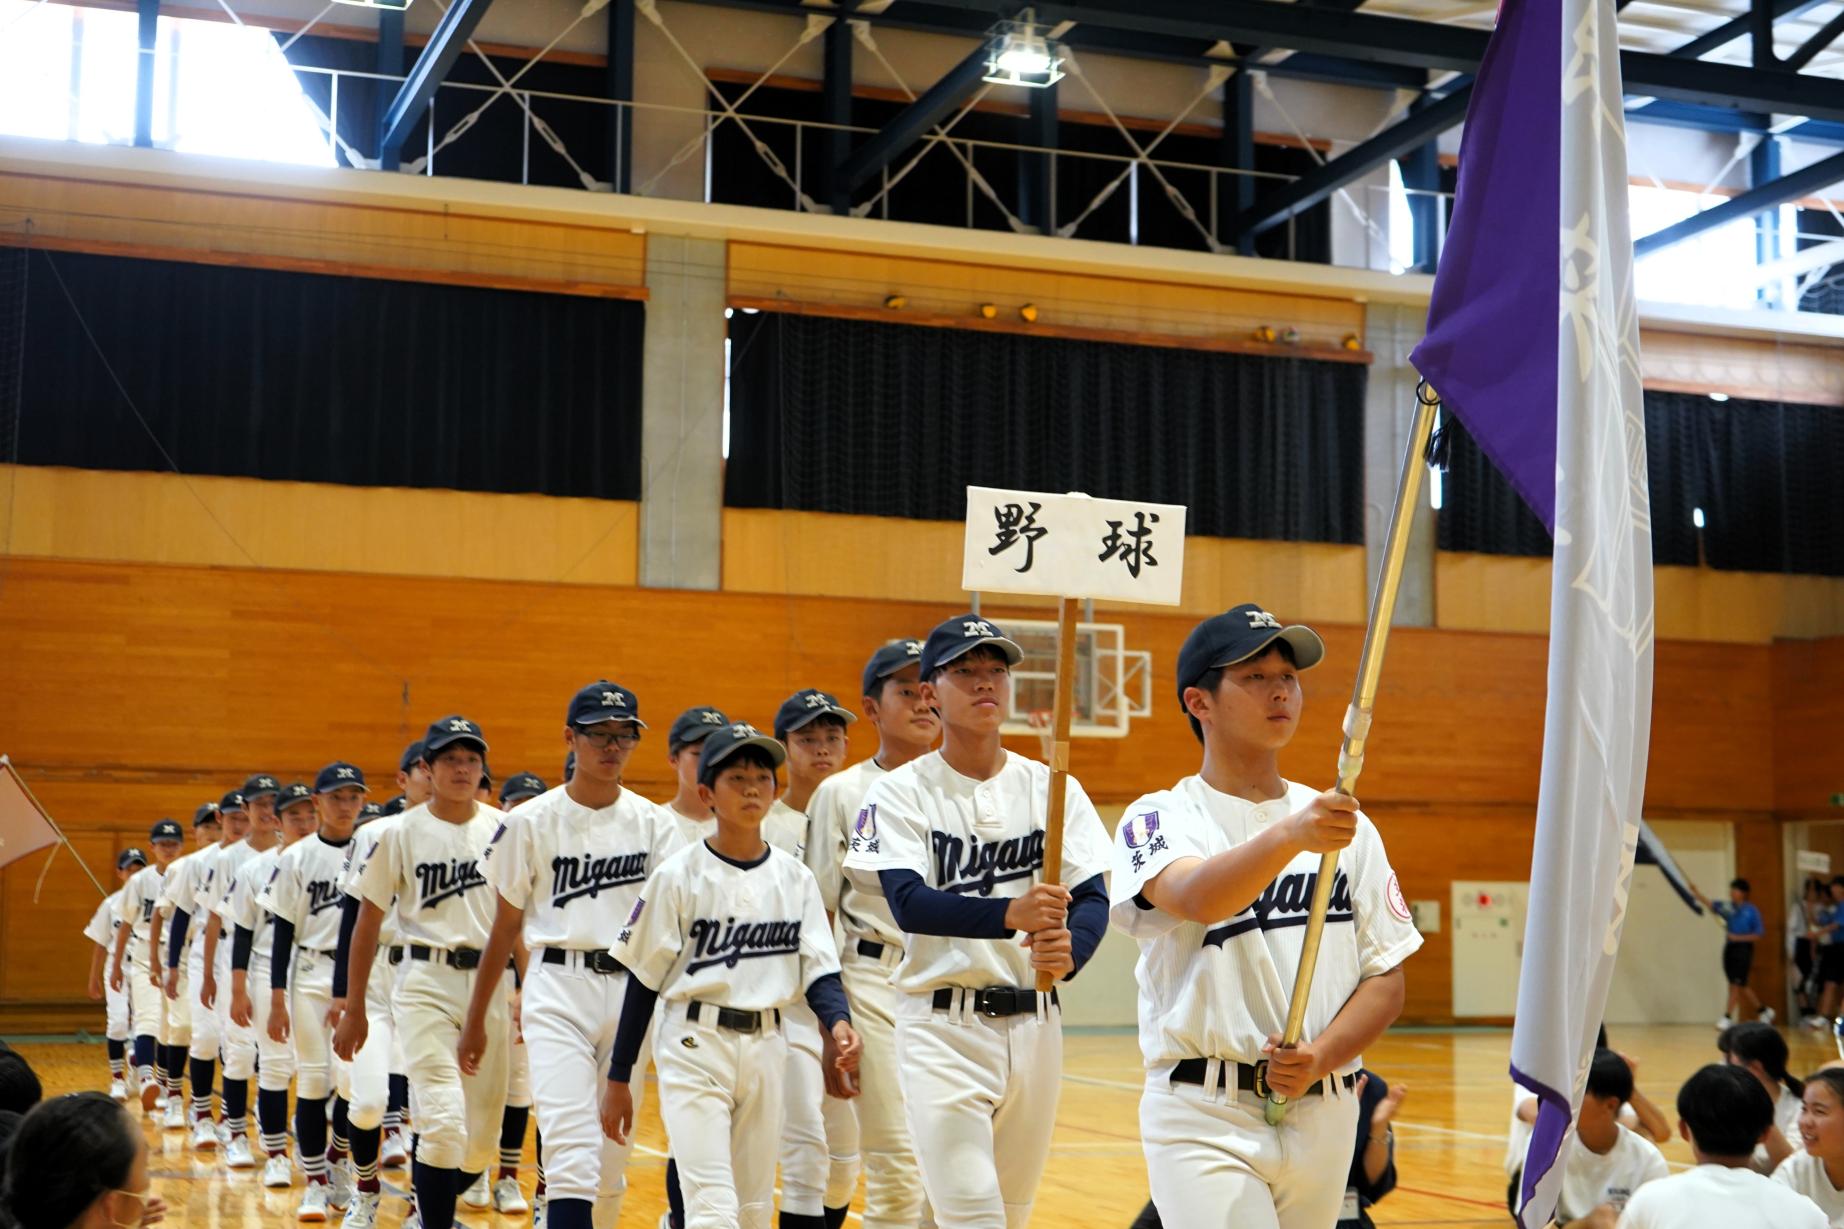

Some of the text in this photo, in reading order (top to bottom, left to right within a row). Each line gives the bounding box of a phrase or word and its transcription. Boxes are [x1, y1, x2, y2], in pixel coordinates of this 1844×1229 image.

[988, 502, 1160, 579] 野球
[963, 621, 994, 637] M
[601, 691, 627, 708] M
[450, 719, 472, 732] M
[1131, 834, 1169, 874] 茨城
